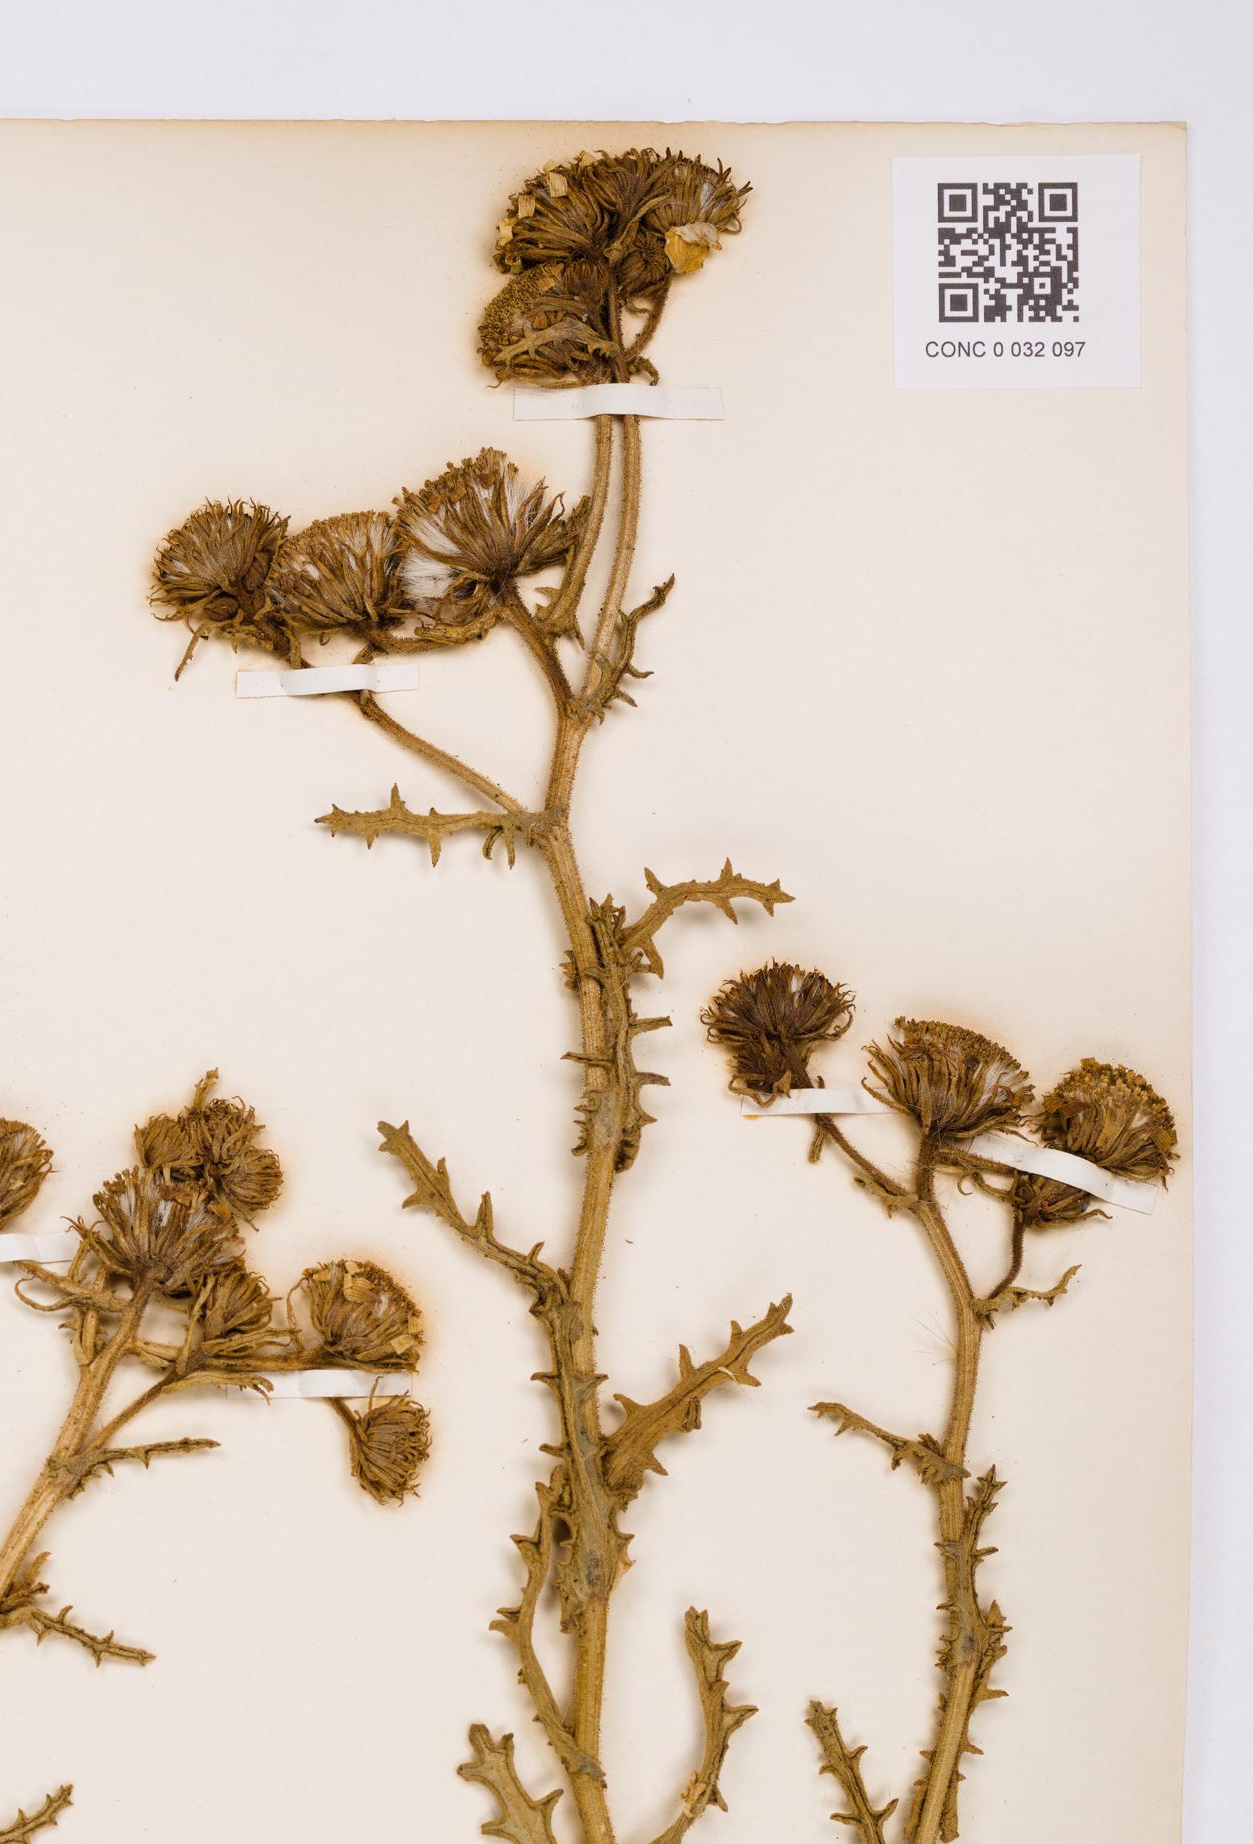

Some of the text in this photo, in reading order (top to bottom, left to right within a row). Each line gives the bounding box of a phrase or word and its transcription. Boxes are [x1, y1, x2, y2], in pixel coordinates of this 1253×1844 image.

[925, 340, 1087, 359] CONC 0 032 097
